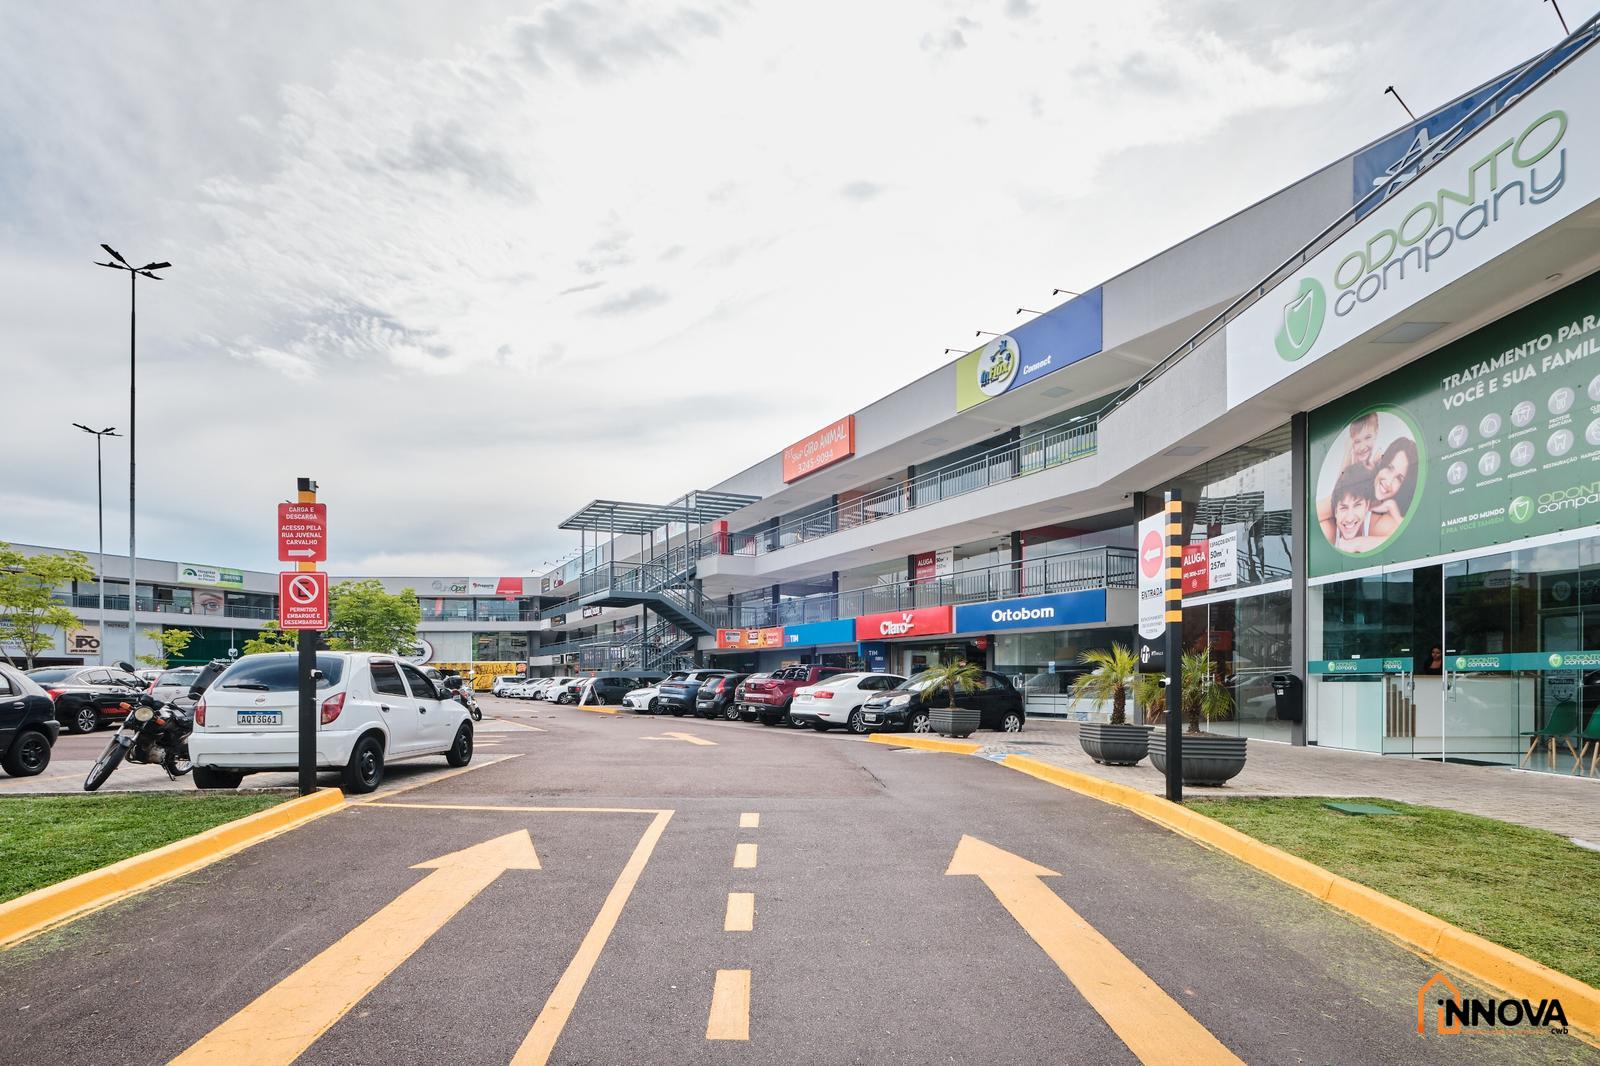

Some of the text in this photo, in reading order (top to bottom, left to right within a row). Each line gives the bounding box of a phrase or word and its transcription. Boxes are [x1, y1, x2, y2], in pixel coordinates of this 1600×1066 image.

[1334, 110, 1568, 291] ODONTO
[1334, 147, 1567, 317] company
[1023, 355, 1052, 375] Connect
[1442, 333, 1553, 391] TRATAMENTO
[1442, 380, 1485, 411] VOCÊ
[1488, 378, 1498, 394] E
[1502, 363, 1537, 388] SUA
[820, 424, 847, 448] ANIMAL
[1447, 516, 1468, 526] MAIOR
[1469, 513, 1479, 521] DO
[1479, 508, 1505, 519] MUNDO
[917, 558, 934, 567] ALUGA
[1183, 551, 1206, 566] ALUGA
[1141, 587, 1164, 600] ENTRADA
[991, 607, 1055, 623] Ortobom
[880, 620, 908, 635] Claro
[790, 634, 799, 643] TIM
